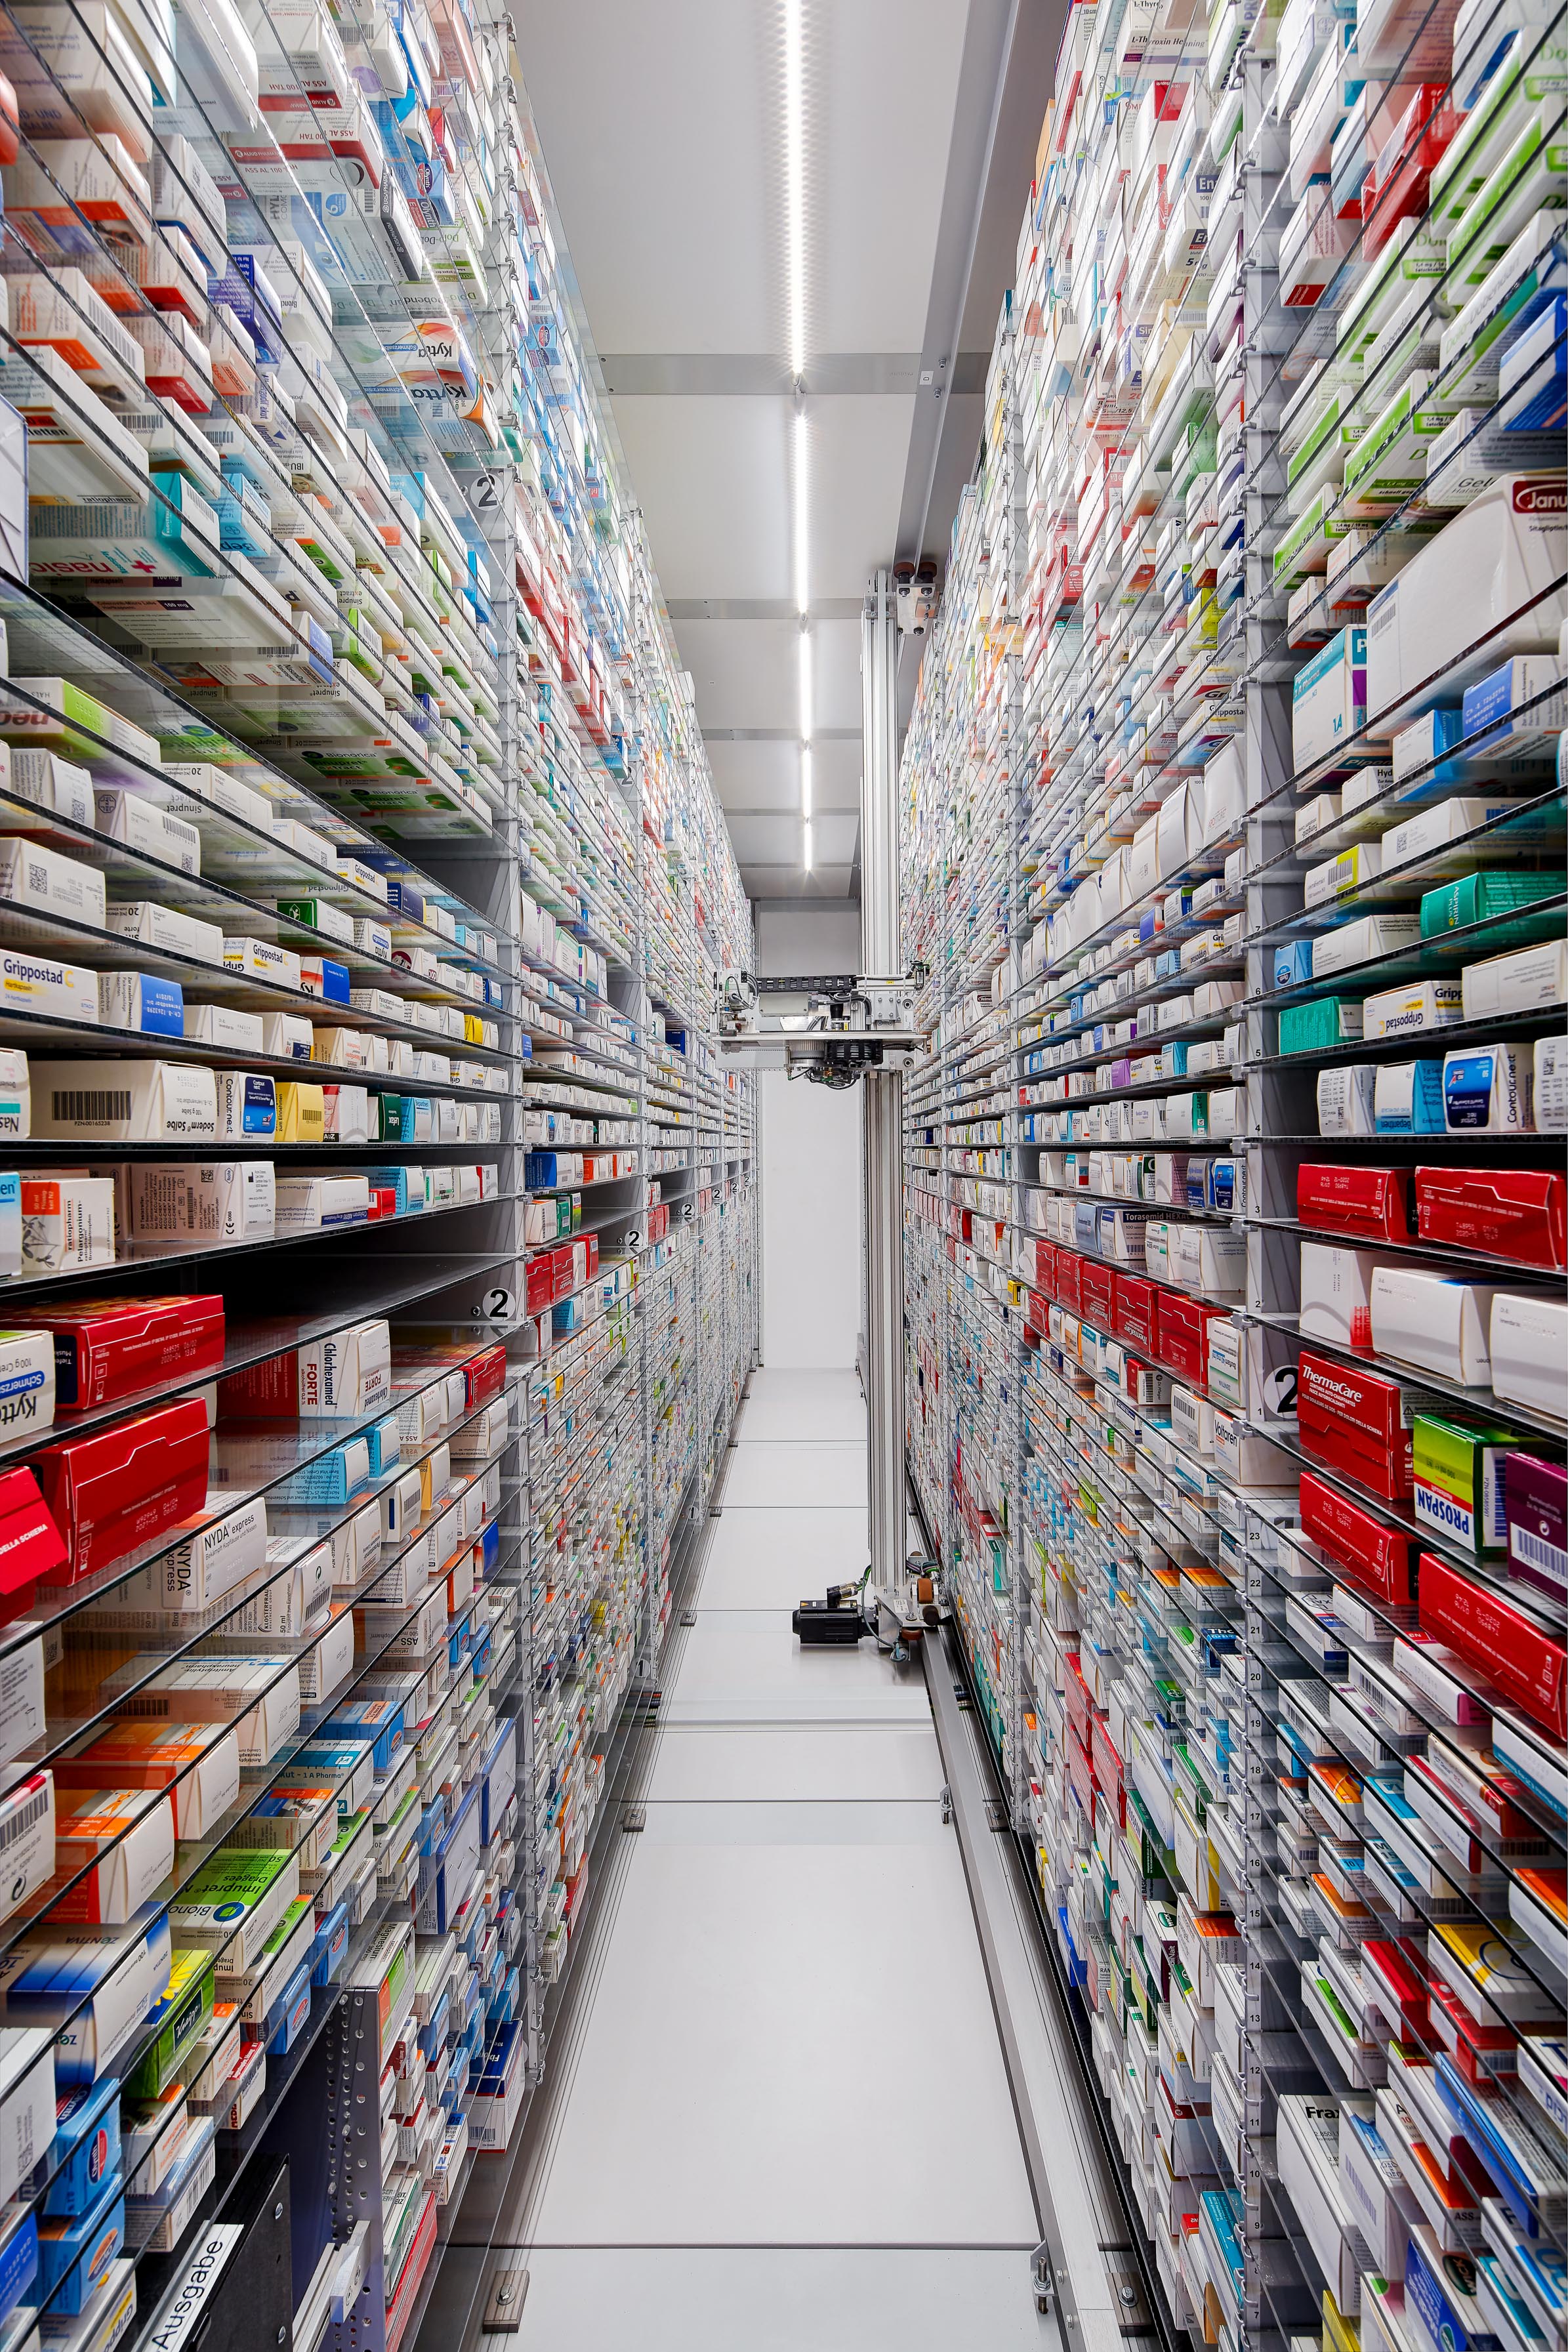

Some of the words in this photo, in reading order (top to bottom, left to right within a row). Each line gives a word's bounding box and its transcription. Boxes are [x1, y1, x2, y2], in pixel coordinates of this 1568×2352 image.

[421, 201, 436, 228] Olynth
[477, 476, 497, 508] 2
[355, 864, 375, 884] Grippostad
[128, 907, 140, 916] 20
[253, 944, 283, 964] Grippostad
[4, 959, 63, 985] Grippostad
[64, 970, 74, 988] C
[1385, 1012, 1424, 1032] Grippostad
[167, 1121, 186, 1132] Salbe
[1380, 1117, 1412, 1130] Bepanthen
[684, 1203, 692, 1216] 2
[629, 1231, 640, 1247] 2
[489, 1289, 508, 1317] 2
[1124, 1323, 1148, 1345] ThermaCare
[307, 1363, 318, 1405] FORTE
[324, 1342, 338, 1406] Chlorhexamed
[365, 1374, 381, 1392] FORTE
[1303, 1365, 1363, 1403] ThermaCare
[1275, 1367, 1299, 1414] 2
[1417, 1487, 1470, 1536] PROSPAN
[20, 1523, 48, 1544] SCHIENA
[232, 1514, 255, 1534] express
[224, 1875, 268, 1884] Dragees
[373, 1923, 397, 1962] Magnesium
[152, 2240, 224, 2351] Ausgabe
